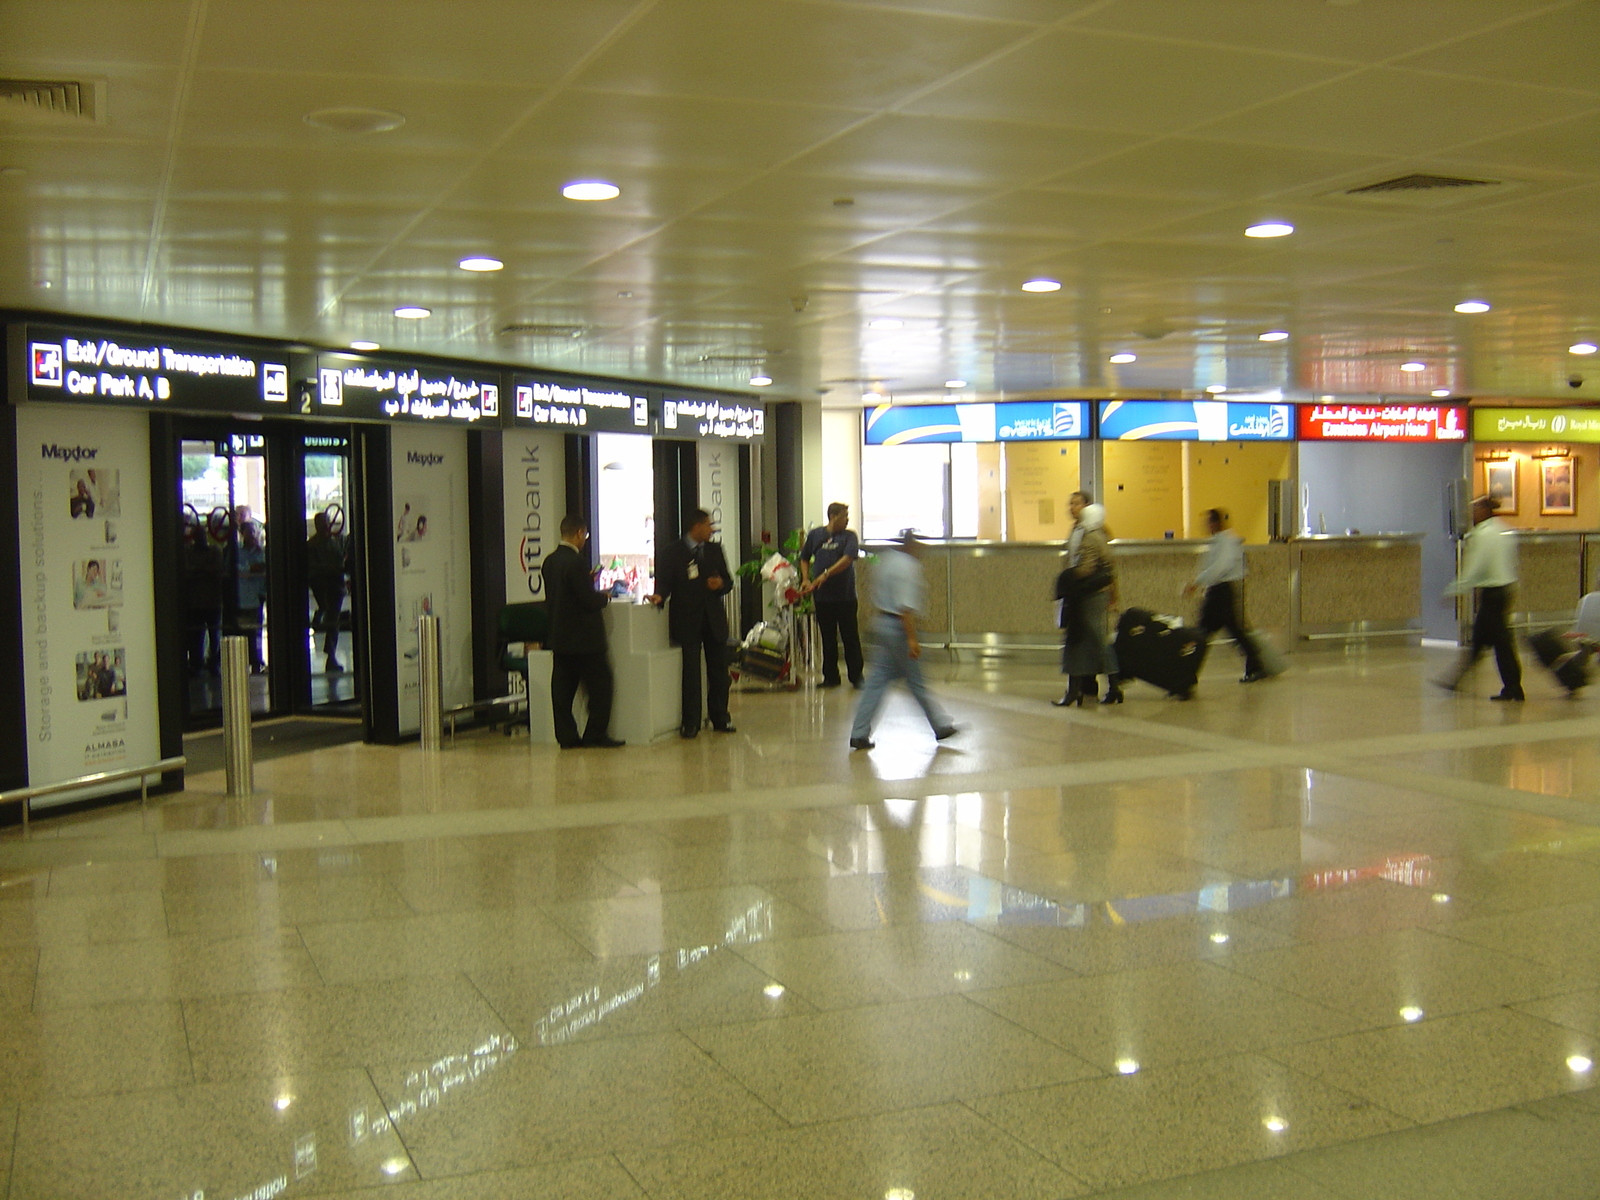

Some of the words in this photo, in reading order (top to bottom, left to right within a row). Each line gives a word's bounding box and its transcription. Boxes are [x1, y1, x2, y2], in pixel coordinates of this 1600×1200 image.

[66, 339, 160, 370] Exit/Ground
[163, 348, 256, 377] Transportation
[67, 370, 97, 395] Car
[101, 373, 135, 397] Park
[157, 377, 170, 399] B
[301, 392, 312, 414] 2
[999, 425, 1054, 438] events
[1322, 421, 1368, 436] Emirates
[1369, 422, 1404, 439] Airport
[1405, 422, 1428, 436] Hotel
[1570, 419, 1587, 433] Royal
[41, 444, 98, 462] Maxtor
[407, 450, 444, 467] Maxtor
[520, 445, 542, 595] citibank
[34, 571, 48, 635] backup
[35, 640, 49, 671] and
[37, 675, 52, 742] Storage
